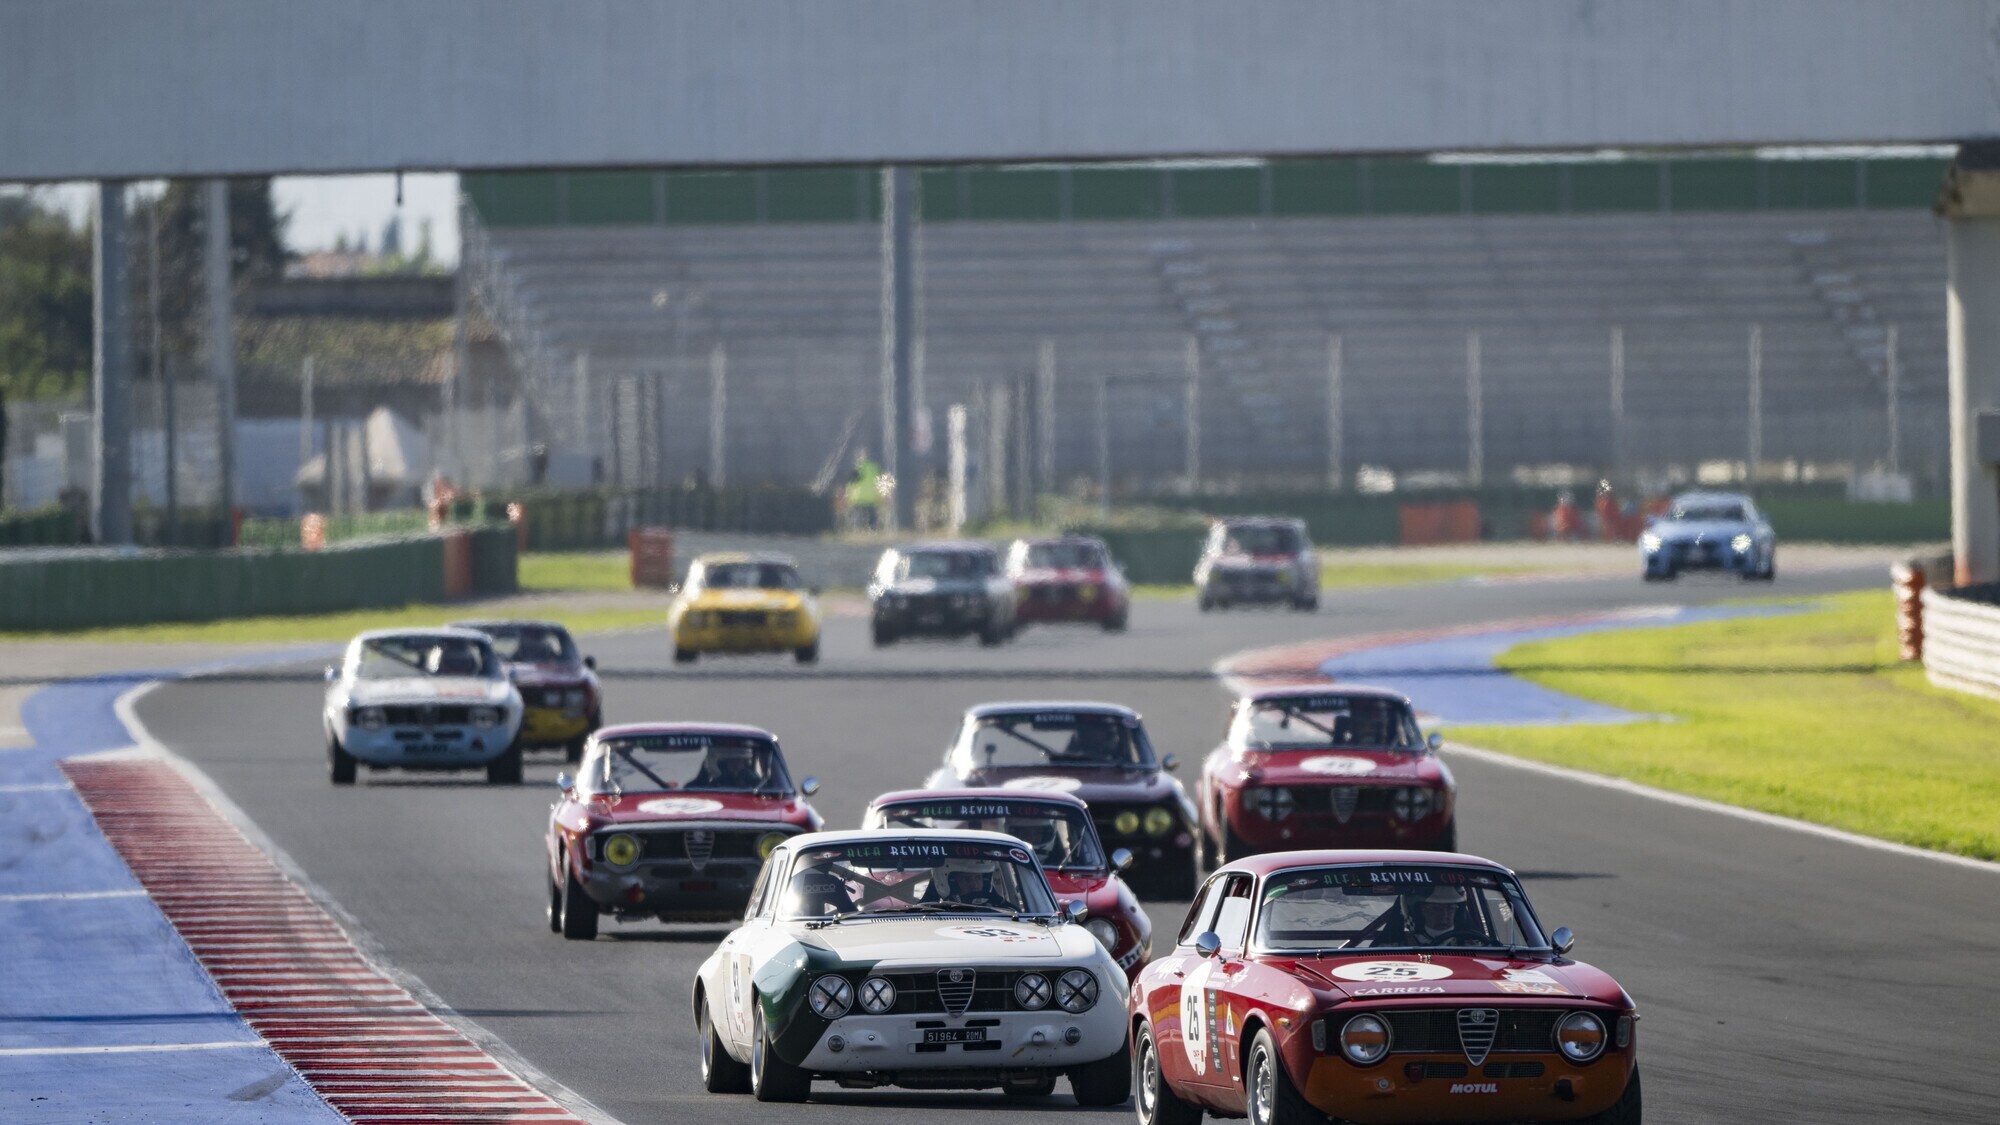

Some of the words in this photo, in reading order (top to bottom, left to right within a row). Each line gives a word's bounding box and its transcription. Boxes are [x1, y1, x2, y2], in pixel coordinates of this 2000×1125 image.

[922, 806, 953, 816] ALFA
[960, 805, 1011, 815] REVIVAL
[847, 847, 881, 857] ALFA
[890, 845, 948, 856] REVIVAL
[955, 846, 980, 857] CUP
[1323, 873, 1361, 884] ALFA
[1370, 872, 1433, 883] REVIVAL
[1440, 873, 1465, 884] CUP
[963, 928, 1020, 938] 93
[1364, 966, 1419, 977] 25
[1354, 986, 1445, 996] CARRERA
[1187, 995, 1200, 1041] 25
[928, 1031, 958, 1042] 51964
[966, 1031, 983, 1041] ROMA
[1449, 1083, 1498, 1094] MOTUL
